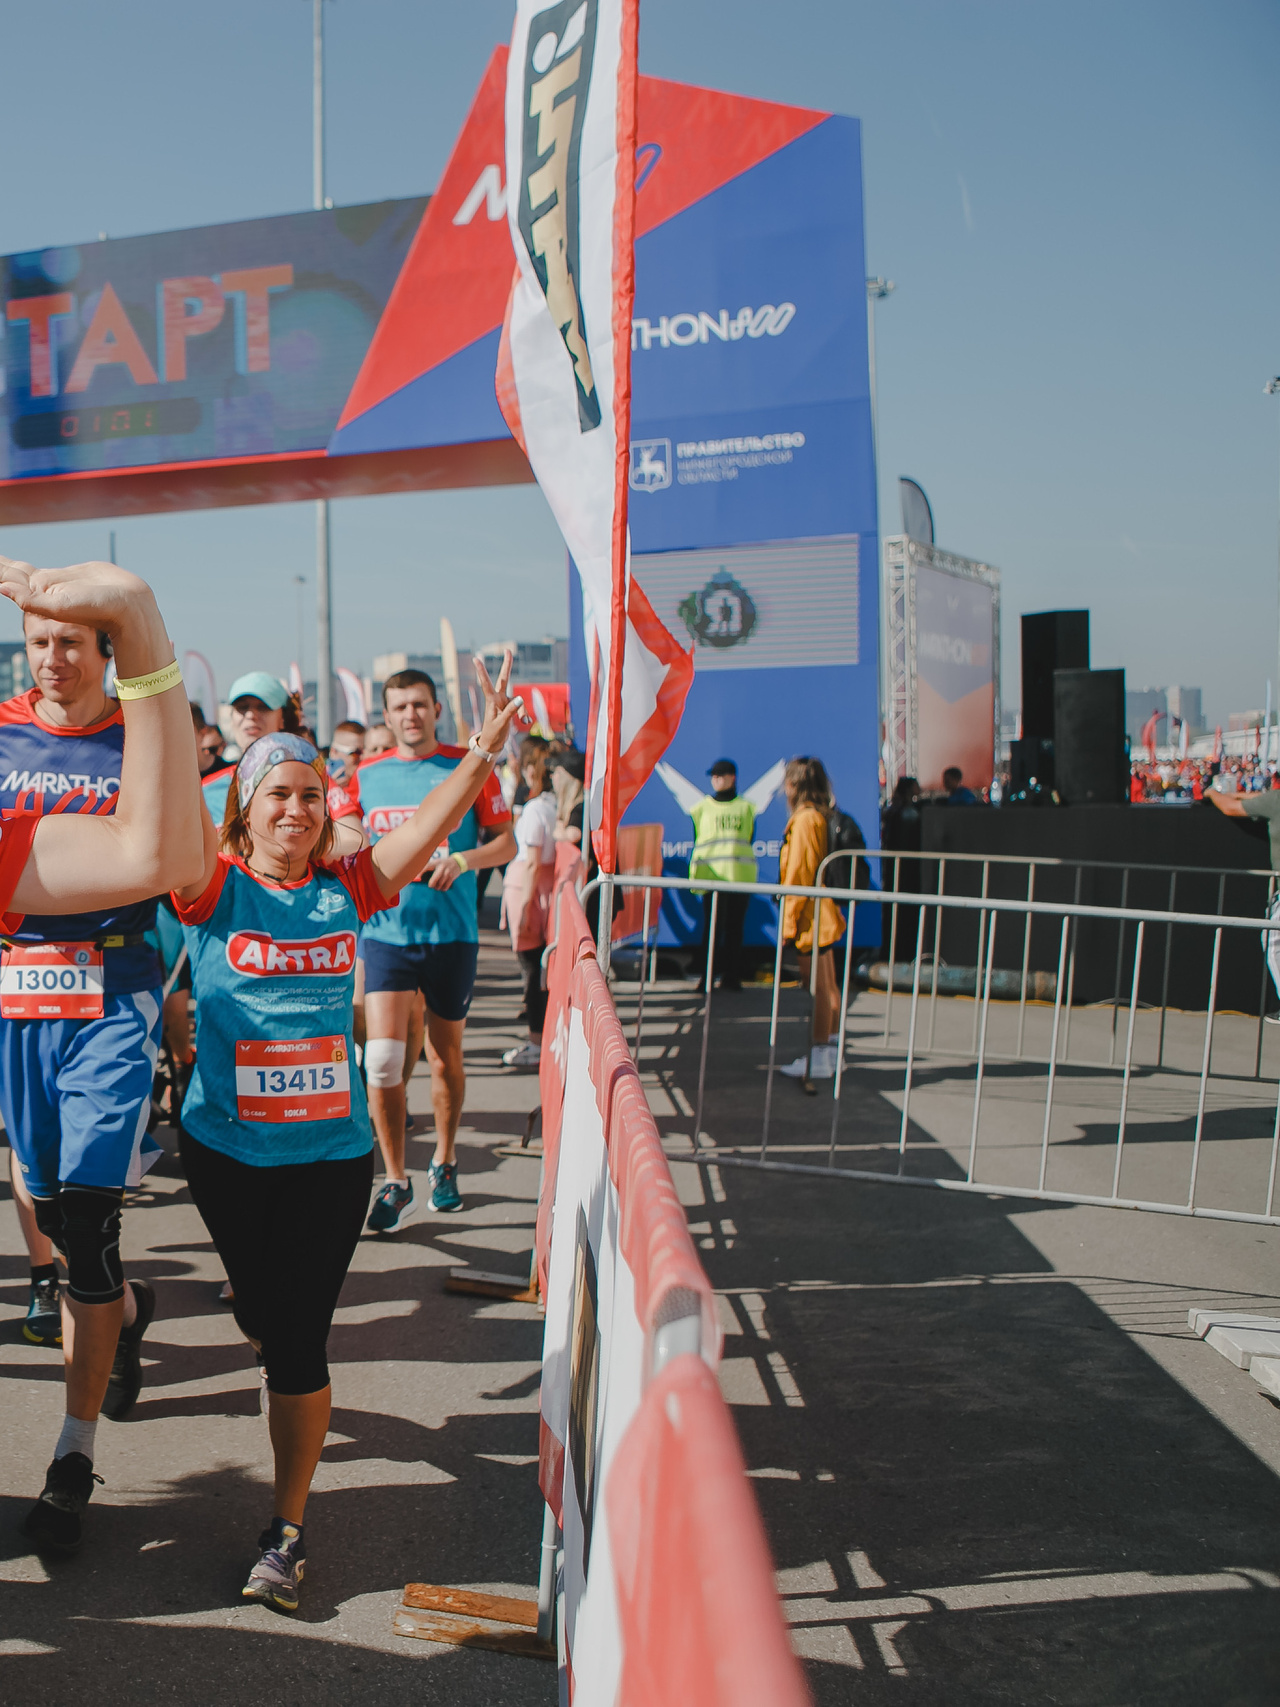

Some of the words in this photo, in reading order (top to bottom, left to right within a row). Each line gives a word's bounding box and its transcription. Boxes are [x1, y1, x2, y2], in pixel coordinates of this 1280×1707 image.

[676, 431, 806, 458] ПРАВИТЕЛЬСТВО
[0, 769, 122, 798] MARATHO
[16, 969, 87, 990] 13001
[256, 1066, 336, 1093] 13415
[283, 1108, 308, 1118] 10KM
